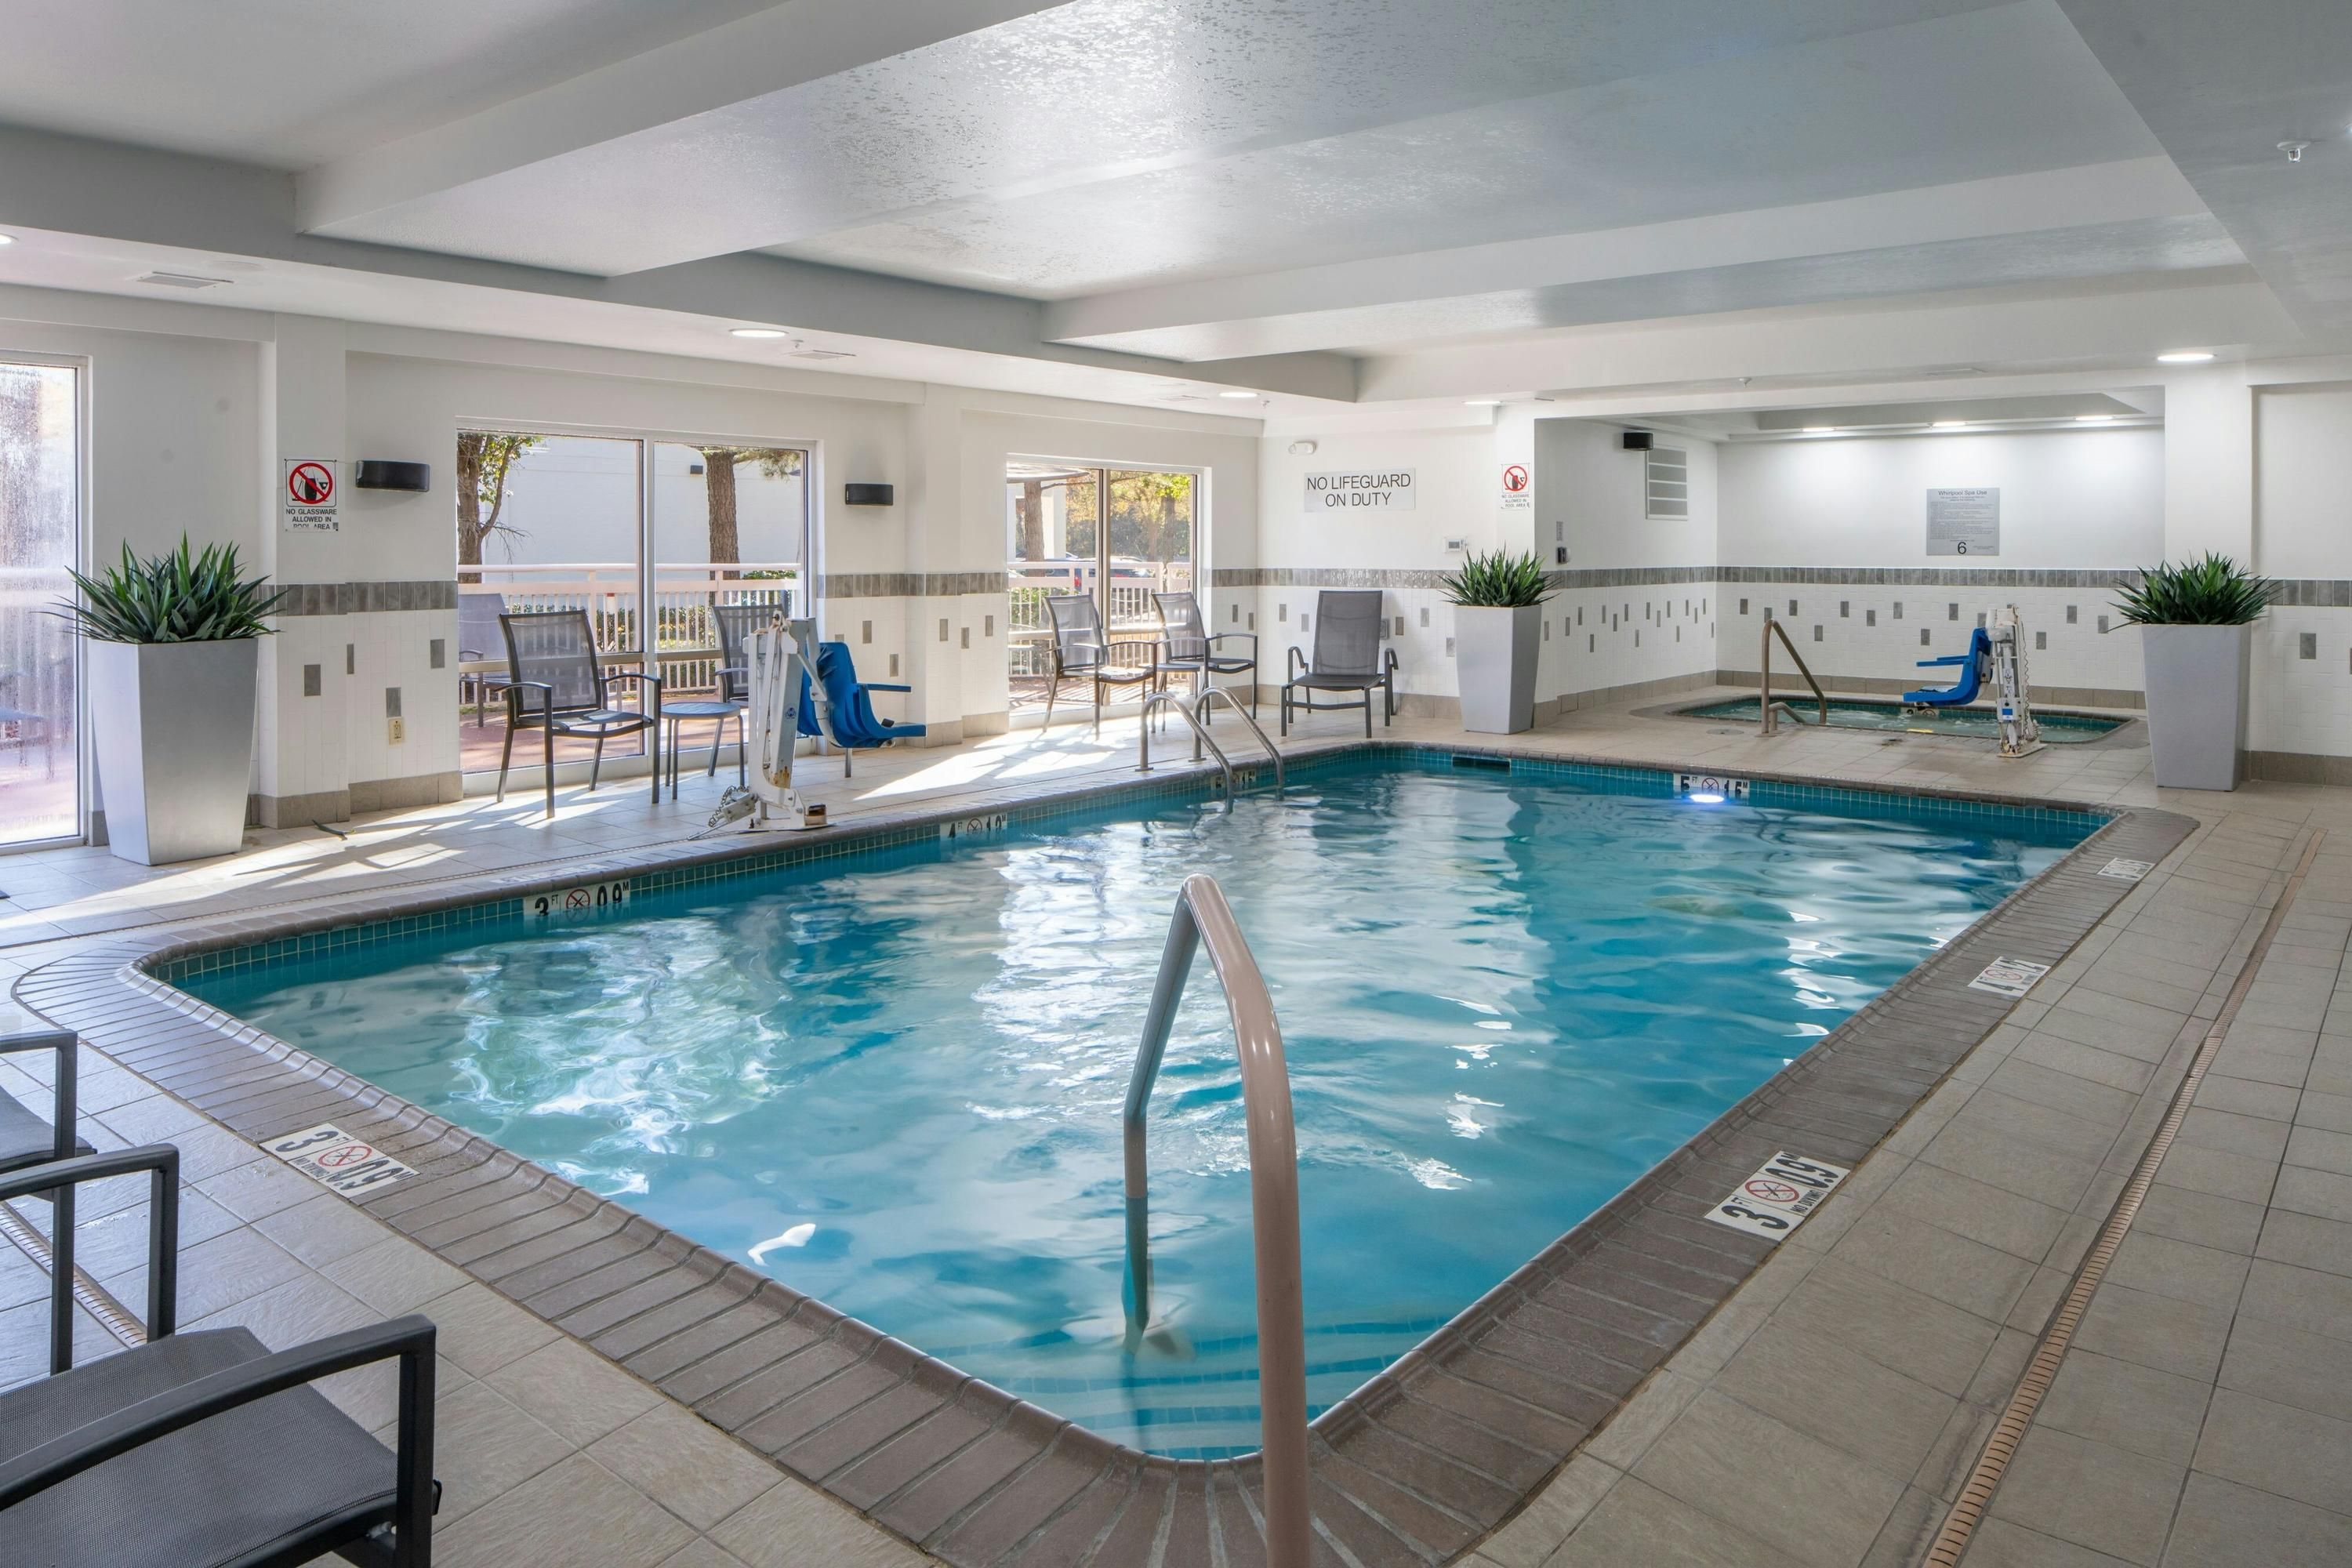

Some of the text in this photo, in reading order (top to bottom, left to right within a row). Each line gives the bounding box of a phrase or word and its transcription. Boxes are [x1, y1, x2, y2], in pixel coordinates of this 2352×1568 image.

[1307, 474, 1410, 490] NO LIFEGUARD
[1325, 492, 1392, 507] ON DUTY
[1958, 541, 1967, 554] 6
[1680, 775, 1690, 789] 5
[551, 895, 558, 905] FT
[622, 881, 630, 891] M
[275, 1131, 339, 1152] 3
[326, 1160, 405, 1190] 0.9
[292, 1157, 330, 1178] NO DIVING
[1765, 1158, 1839, 1189] 0.9
[1731, 1196, 1753, 1207] FT
[1790, 1189, 1824, 1213] NO DIVING
[1721, 1205, 1790, 1230] 3
